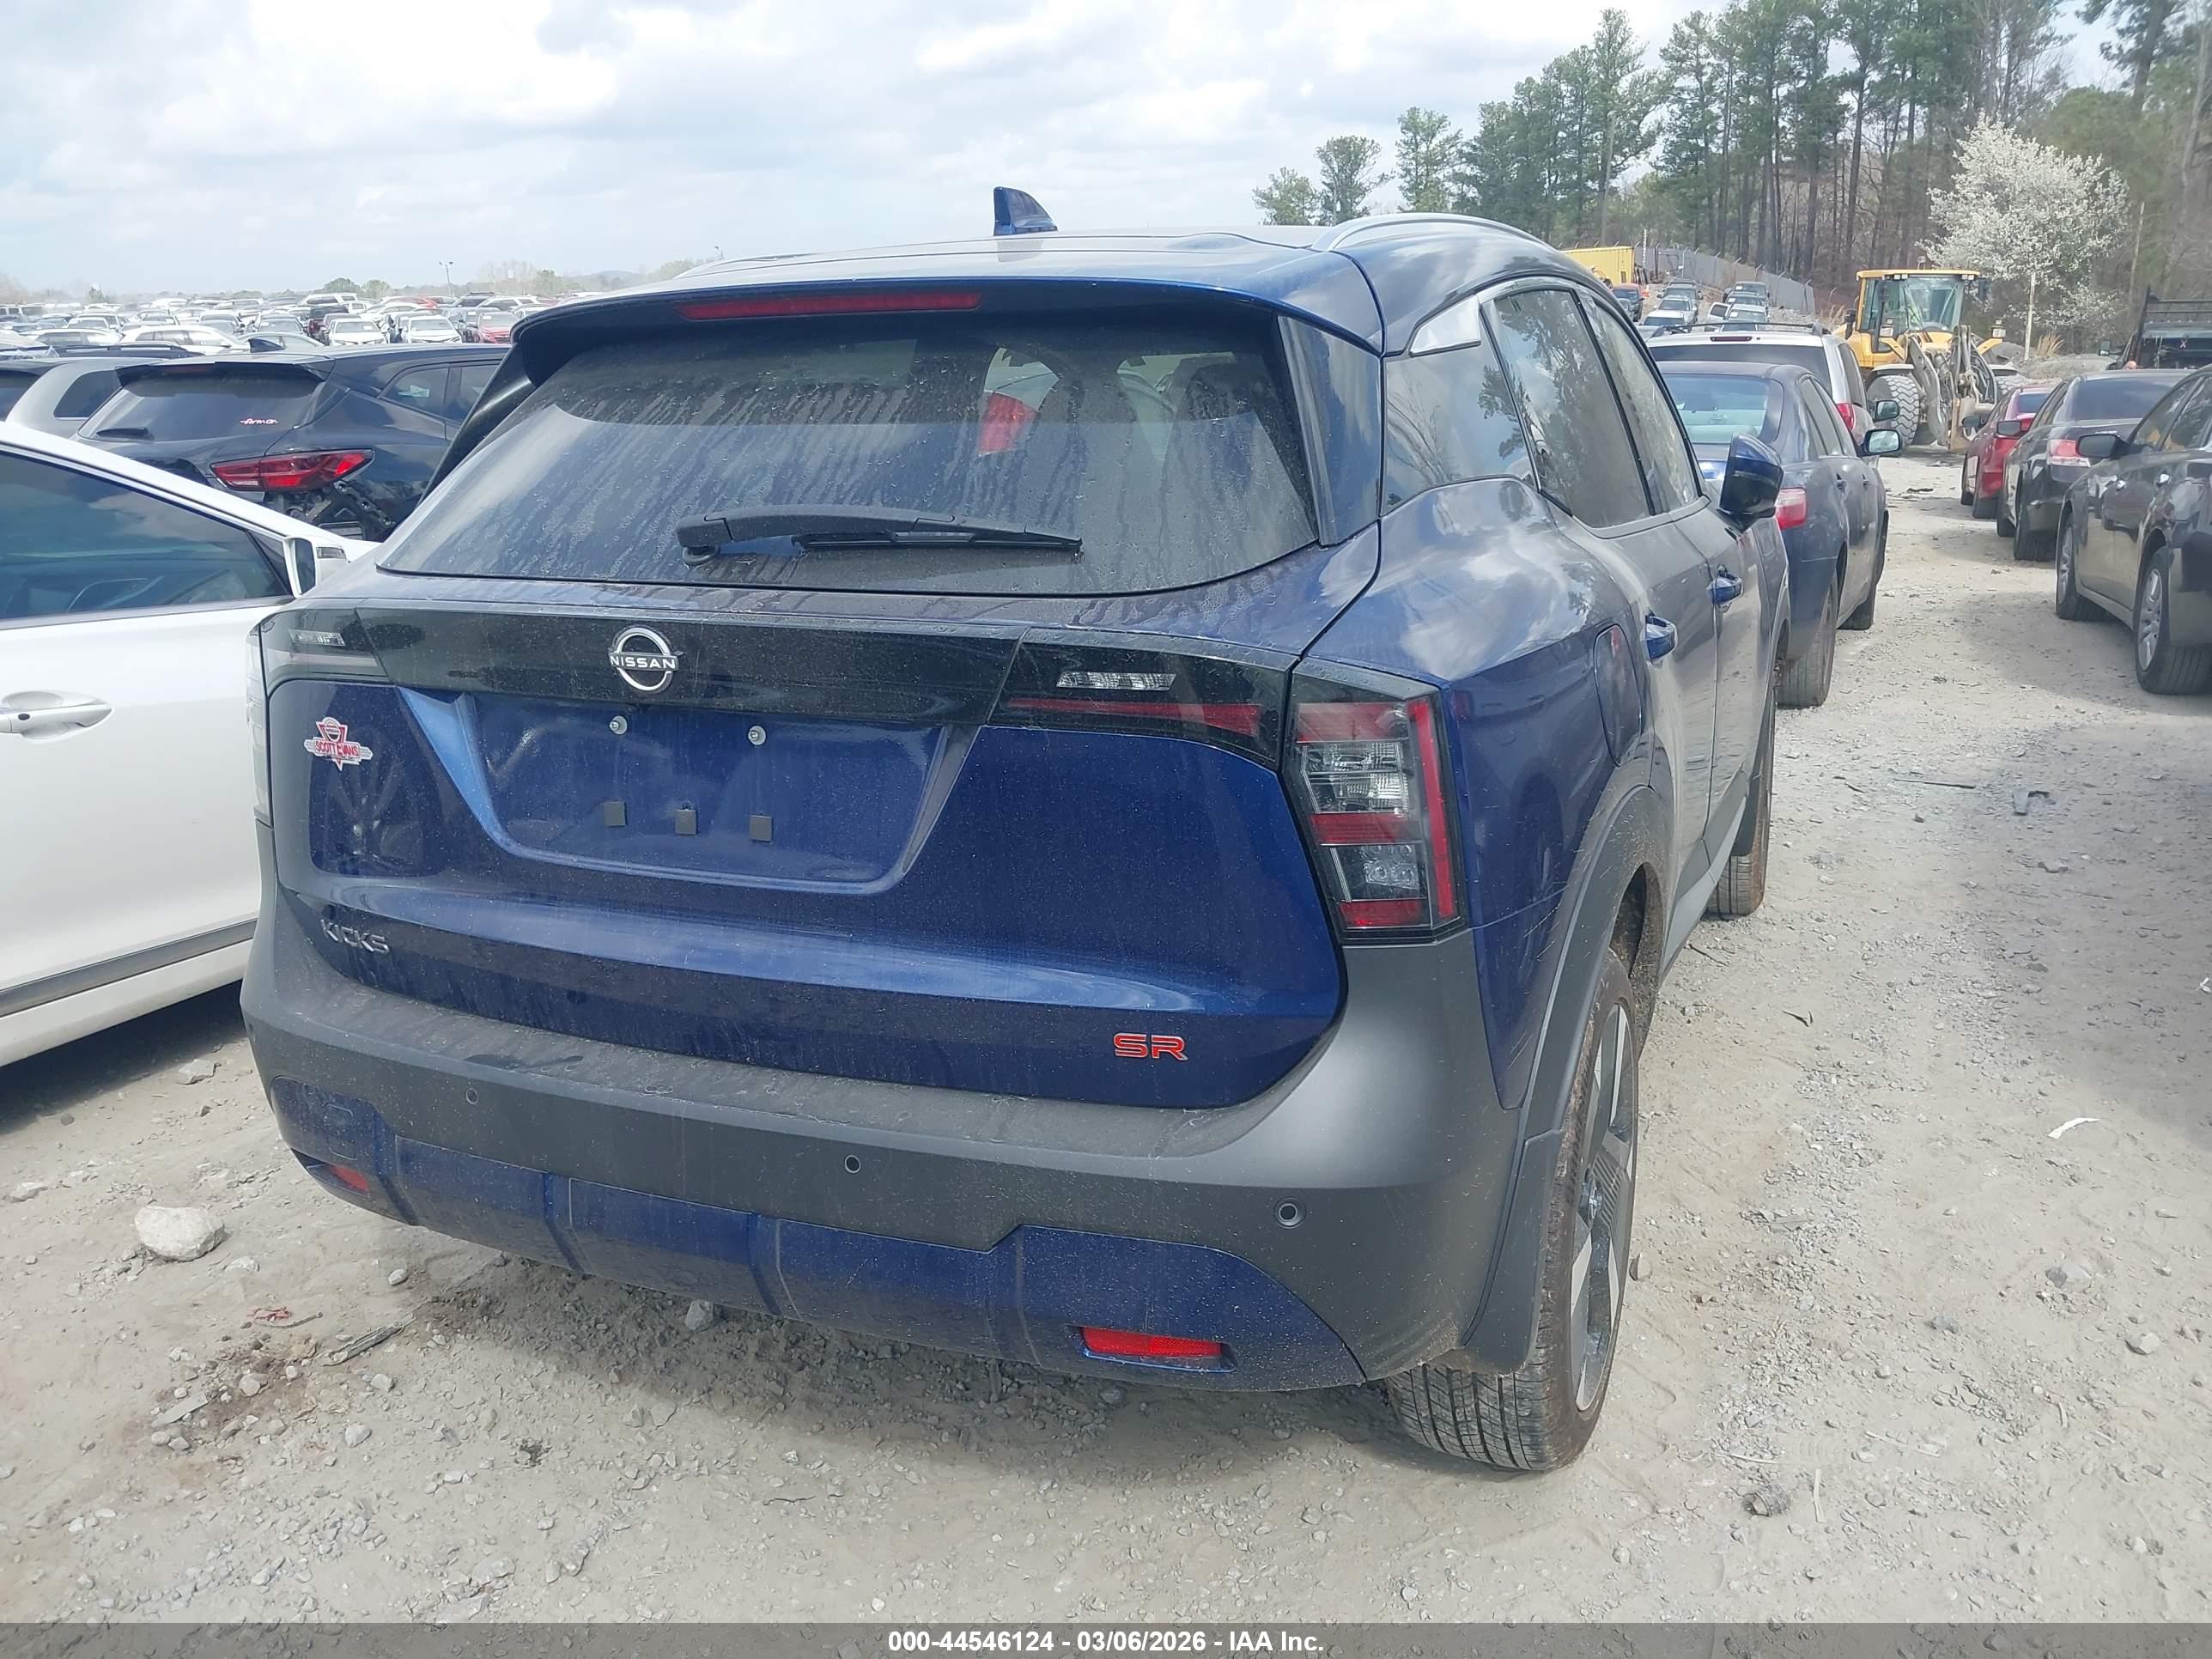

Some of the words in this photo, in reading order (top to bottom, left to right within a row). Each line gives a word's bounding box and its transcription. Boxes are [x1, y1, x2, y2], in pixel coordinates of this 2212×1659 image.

[610, 655, 676, 669] NISSAN
[315, 740, 336, 756] SCOTT
[336, 743, 359, 757] EVANS
[320, 919, 390, 955] KICKS
[1113, 1032, 1188, 1060] SR
